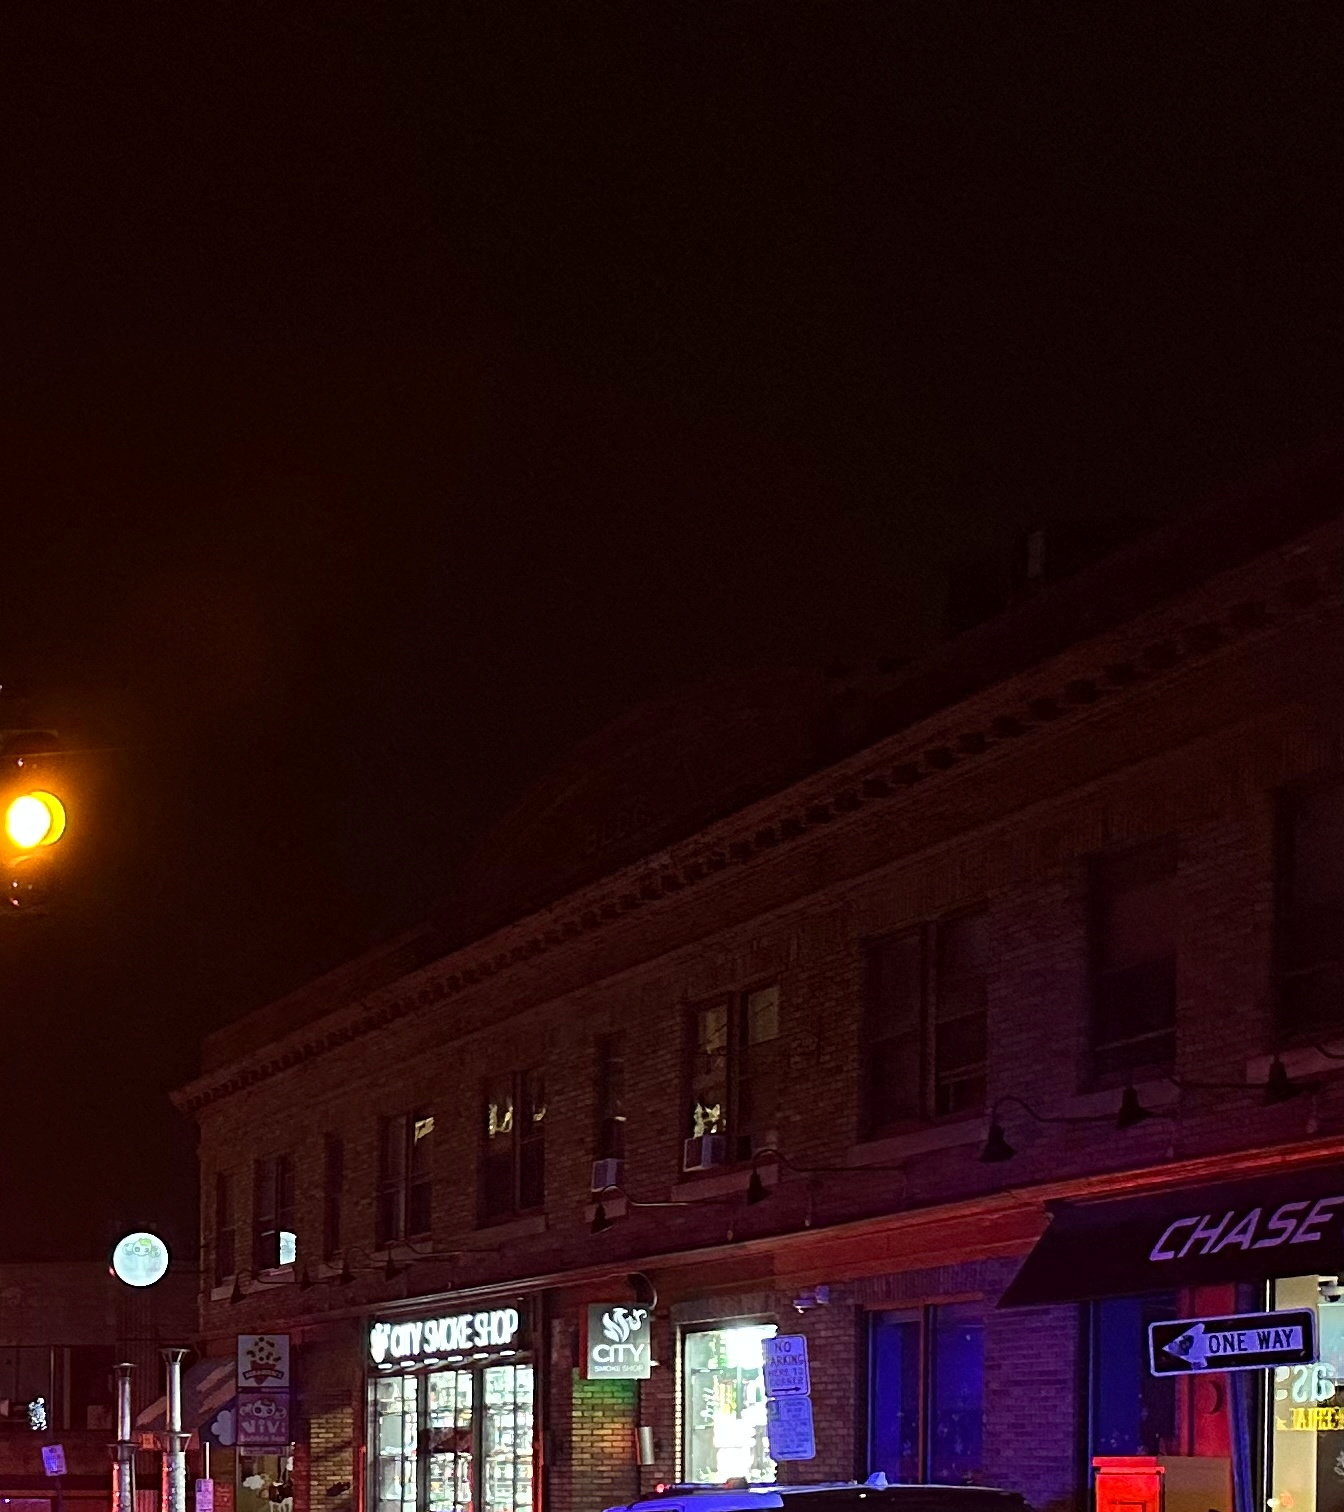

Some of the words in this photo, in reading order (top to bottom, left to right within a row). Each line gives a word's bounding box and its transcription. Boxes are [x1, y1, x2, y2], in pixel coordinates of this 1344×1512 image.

[1149, 1196, 1344, 1261] CHASE
[391, 1322, 423, 1358] CITY
[424, 1313, 473, 1352] SMOKE
[474, 1308, 519, 1346] SHOP
[1208, 1332, 1248, 1355] ONE
[1256, 1328, 1294, 1352] WAY
[592, 1343, 645, 1363] CITY
[775, 1341, 792, 1353] NO
[594, 1365, 621, 1373] SMOKE
[621, 1365, 645, 1373] SHOP
